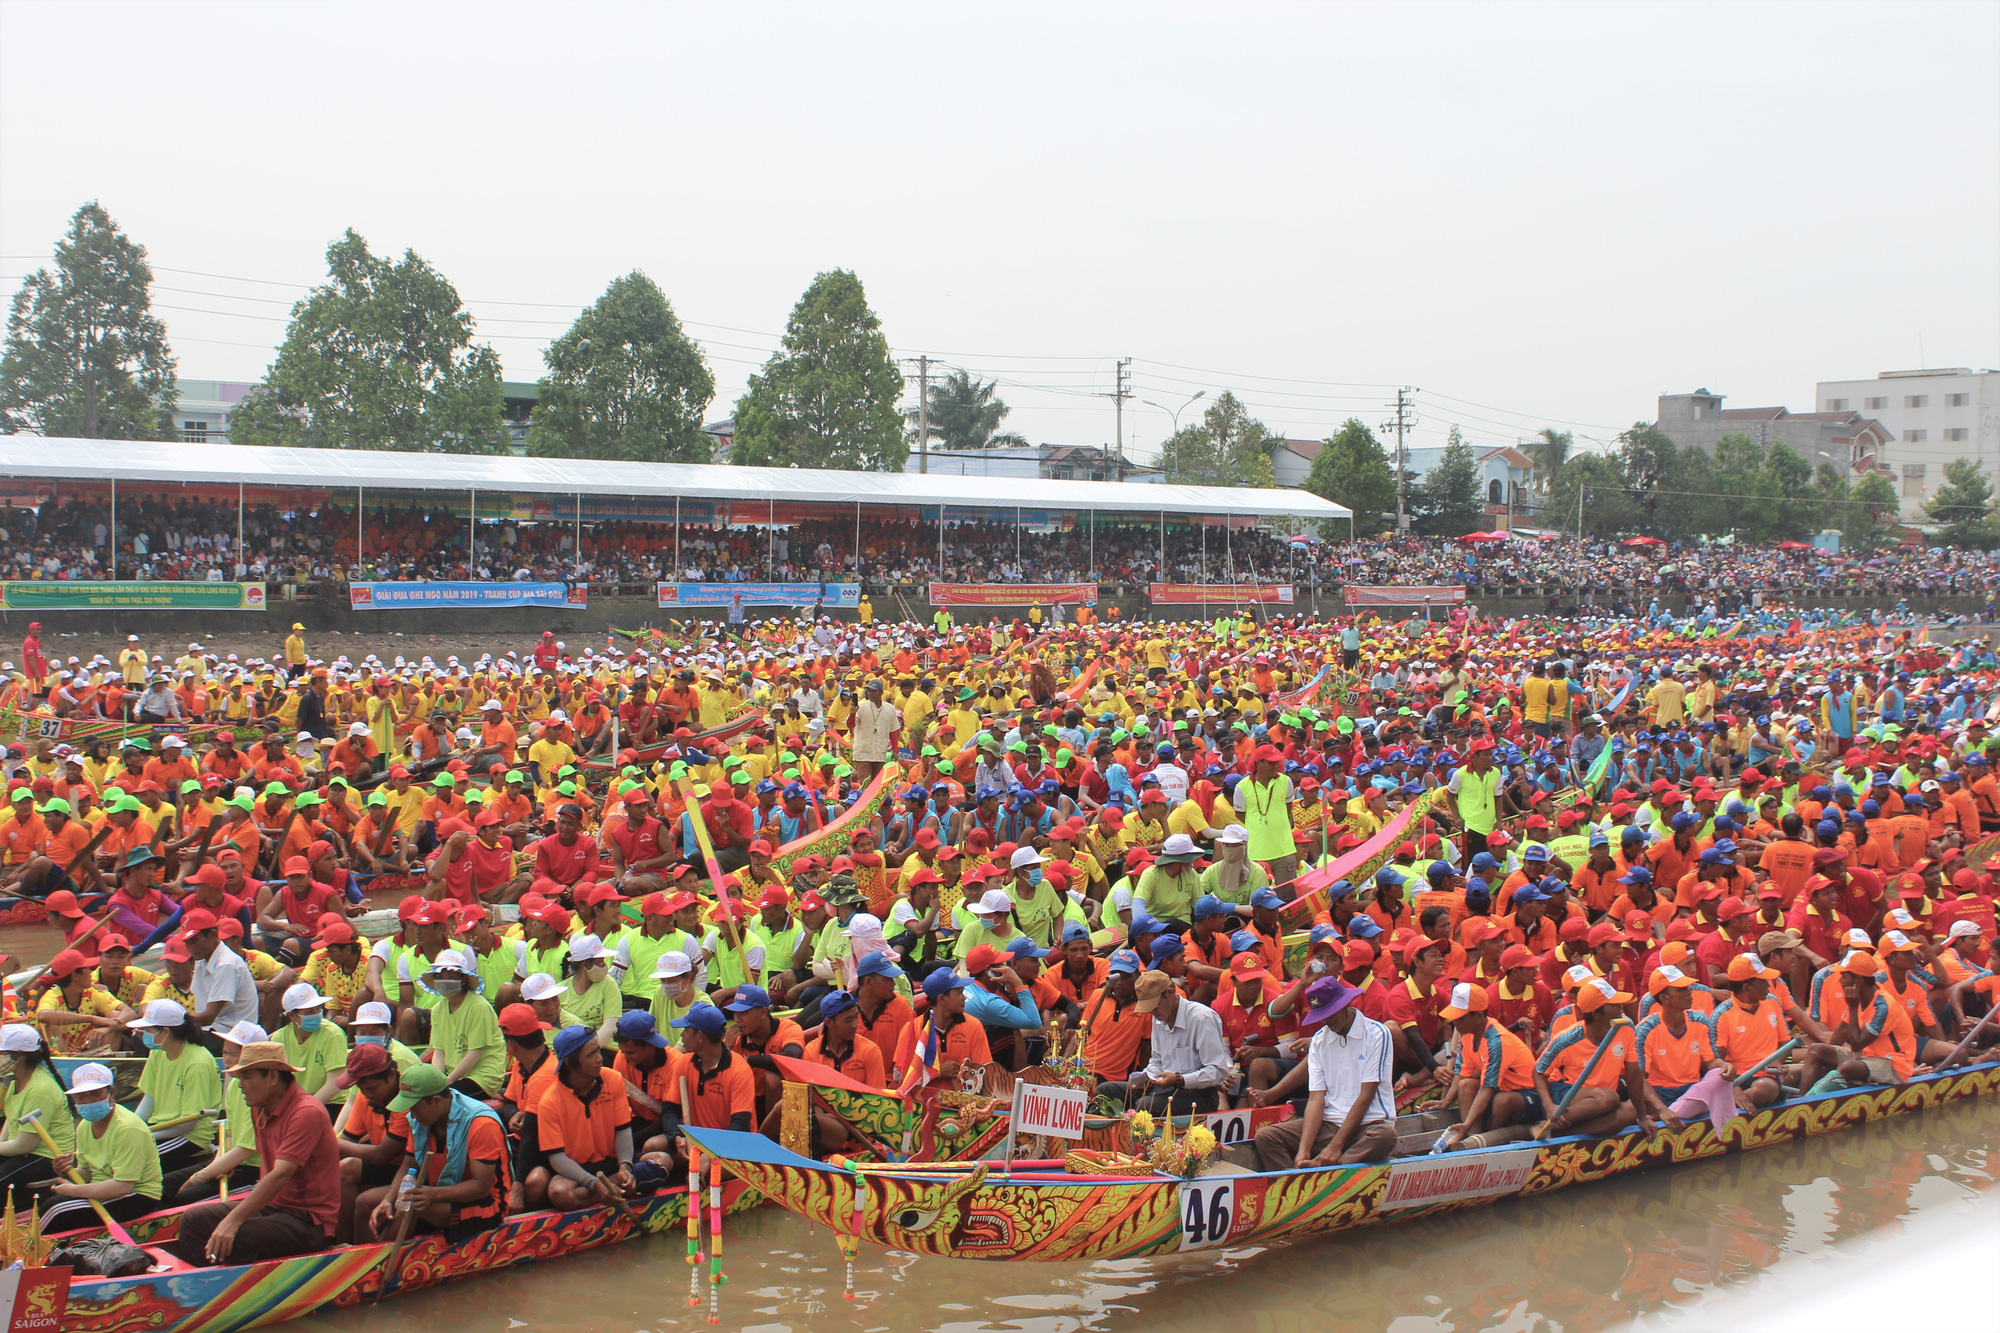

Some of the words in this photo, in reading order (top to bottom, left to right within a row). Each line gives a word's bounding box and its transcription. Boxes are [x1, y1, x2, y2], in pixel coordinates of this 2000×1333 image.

[376, 588, 392, 601] GIẢI
[393, 590, 408, 600] ĐUA
[409, 590, 424, 600] GHE
[425, 590, 441, 600] NGO
[442, 588, 459, 599] NĂM
[460, 590, 478, 599] 2019
[484, 589, 507, 599] TRANH
[508, 587, 521, 599] CÚP
[522, 589, 536, 598] BIA
[40, 720, 60, 737] 37
[1022, 1087, 1051, 1129] VĨNH
[1051, 1098, 1084, 1132] LONG
[1385, 1172, 1408, 1203] WAT
[1185, 1186, 1230, 1244] 46
[14, 1317, 58, 1329] SAIGON
